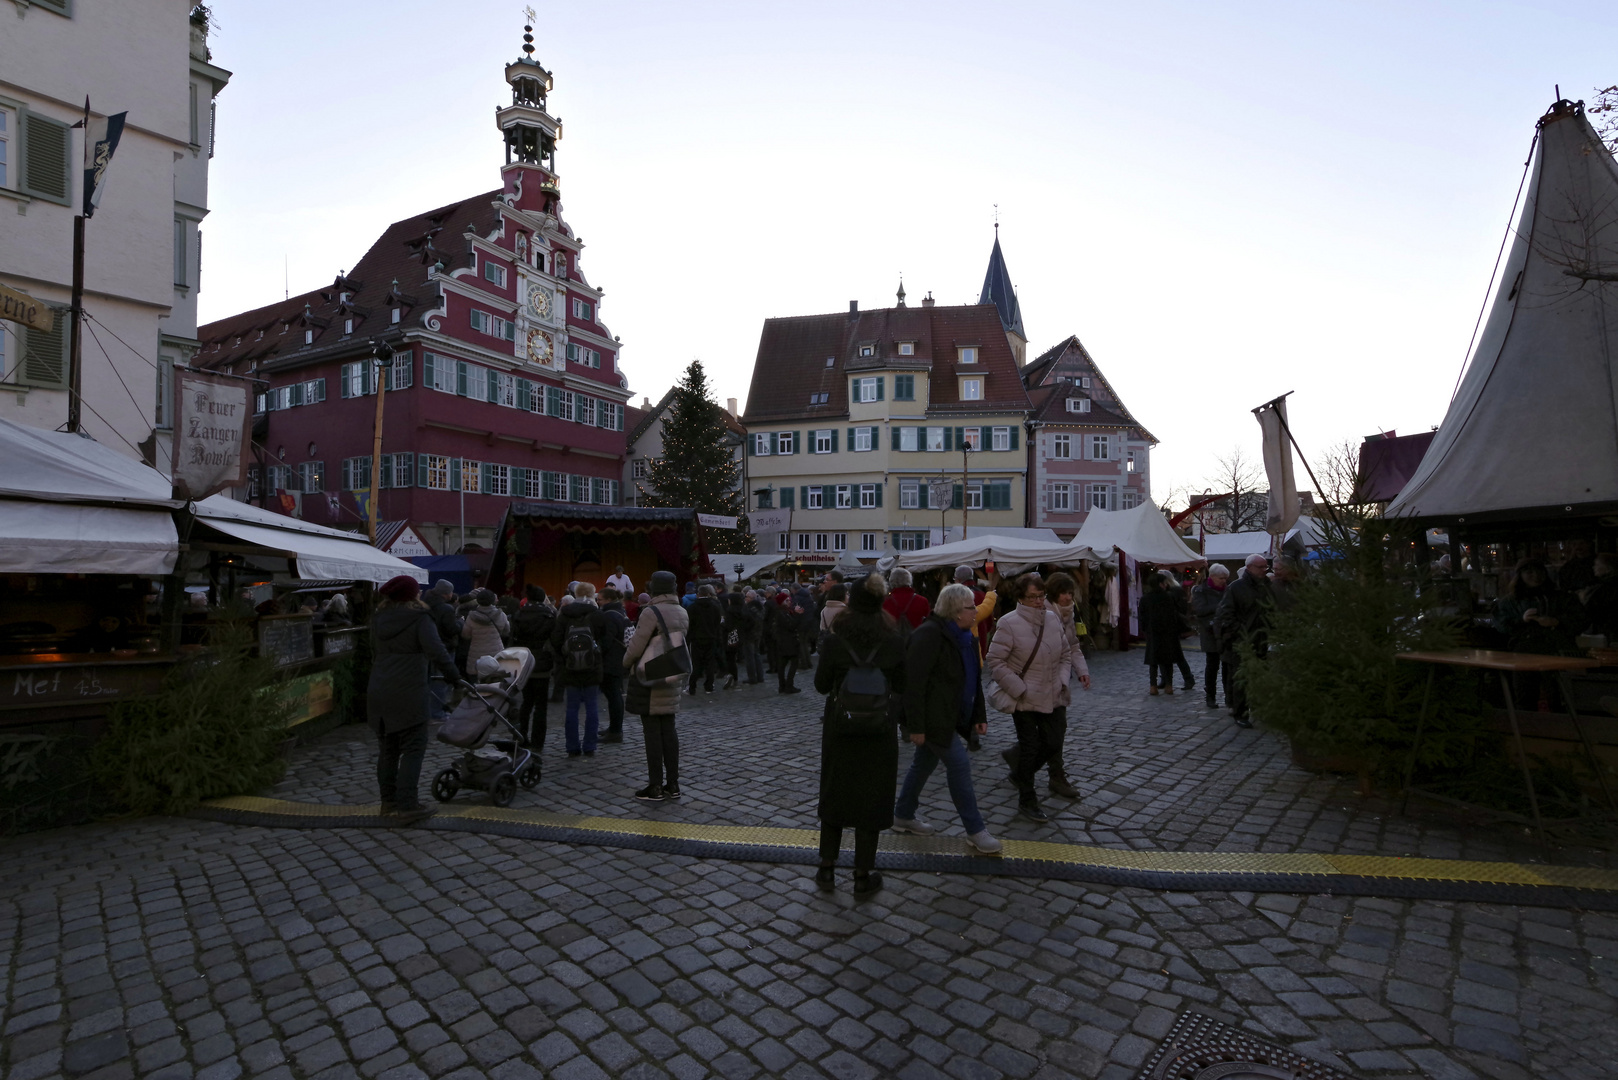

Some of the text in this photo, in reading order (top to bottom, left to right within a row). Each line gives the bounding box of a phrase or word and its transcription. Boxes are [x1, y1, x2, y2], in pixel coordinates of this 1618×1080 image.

[0, 293, 37, 323] rne
[194, 391, 236, 417] Feuer
[187, 417, 238, 445] Zangen
[188, 443, 232, 467] Bowle
[13, 671, 62, 696] Met
[73, 679, 103, 696] 4,5
